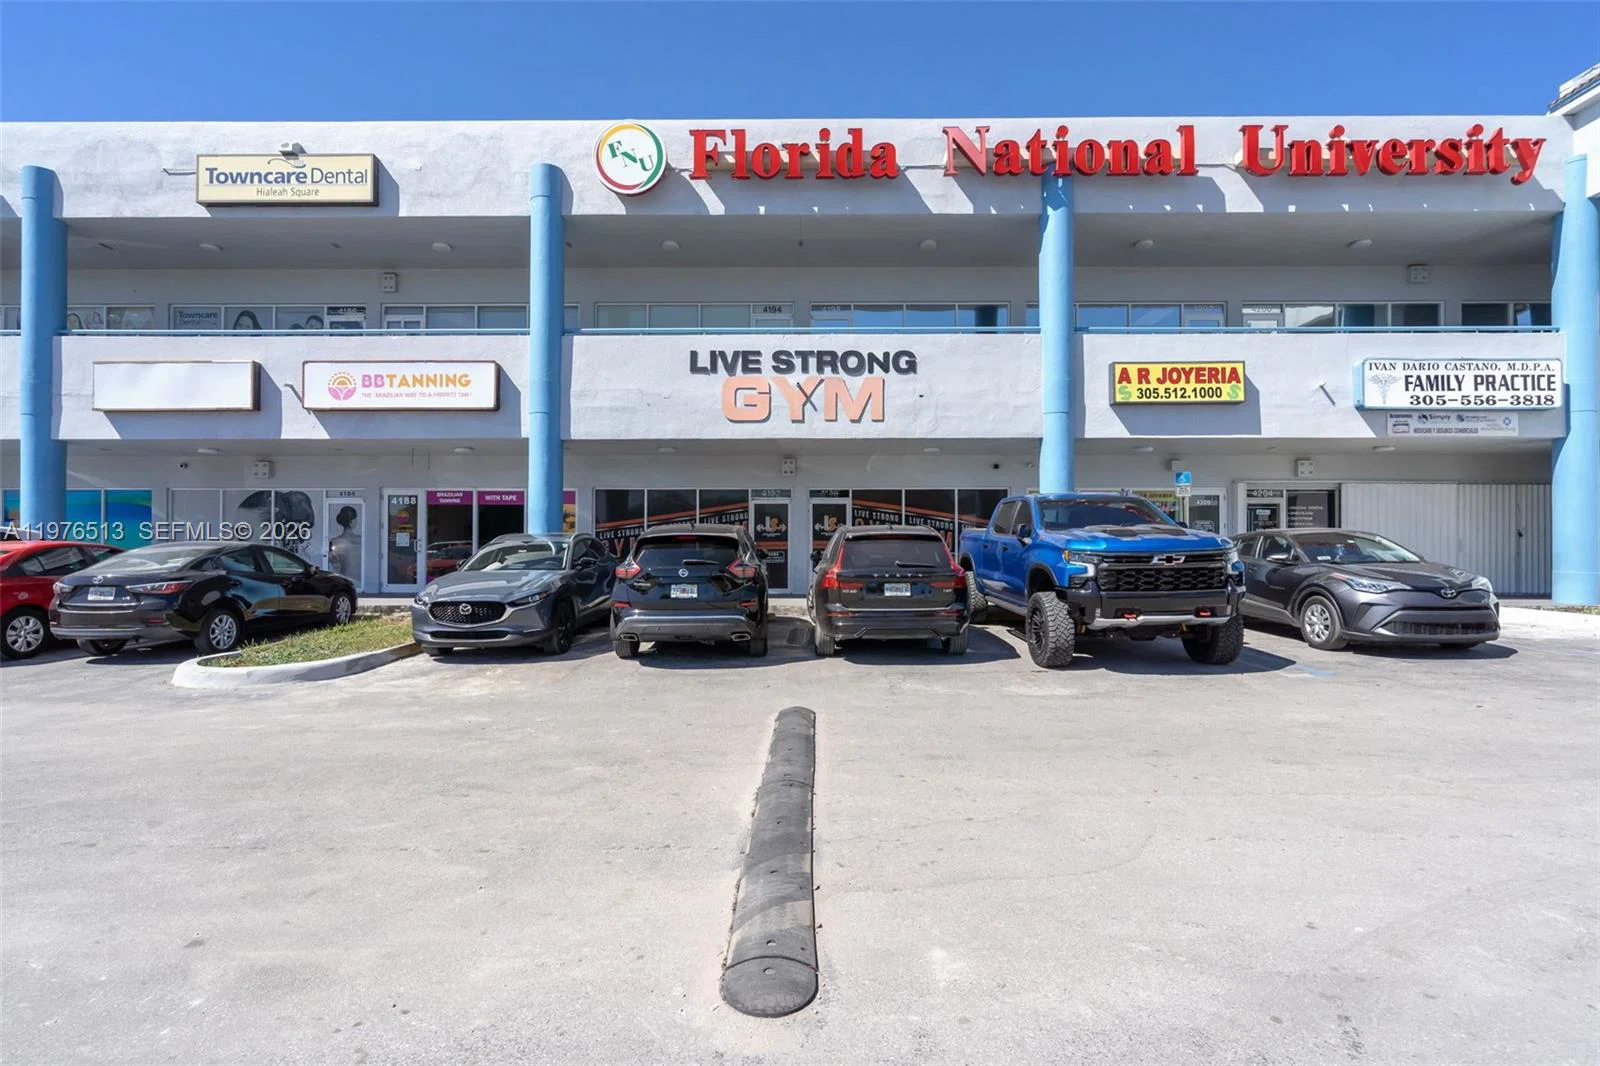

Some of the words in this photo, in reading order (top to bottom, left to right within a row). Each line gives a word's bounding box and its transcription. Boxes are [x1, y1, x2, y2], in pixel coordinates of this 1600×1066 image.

[607, 140, 655, 172] FNU
[689, 127, 900, 180] Florida
[942, 124, 1199, 177] National
[1239, 123, 1547, 185] University
[205, 167, 307, 185] Towncare
[311, 167, 368, 185] Dental
[256, 187, 288, 197] Hialeah
[290, 187, 320, 198] Square
[762, 305, 782, 313] 4194
[689, 350, 763, 376] LIVE
[771, 350, 918, 377] STRONG
[1368, 362, 1397, 371] IVAN
[1402, 362, 1440, 371] DARIO
[1507, 363, 1555, 372] M.D.P.A.
[1117, 367, 1132, 384] A
[1137, 367, 1151, 384] R
[1156, 367, 1241, 384] JOYERIA
[1404, 374, 1465, 392] FAMILY
[1473, 374, 1557, 392] PRACTICE
[721, 376, 886, 424] GYM
[1136, 387, 1222, 399] 305.512.1000
[1409, 394, 1555, 406] 305-556-3818
[391, 496, 416, 505] 4188
[703, 516, 720, 525] LIVE
[721, 511, 749, 523] STRONG
[854, 509, 870, 519] LIVE
[872, 511, 899, 522] STRONG
[909, 516, 925, 526] LIVE
[927, 520, 954, 530] STRONG
[599, 531, 616, 540] LIVE
[617, 527, 645, 538] STRONG
